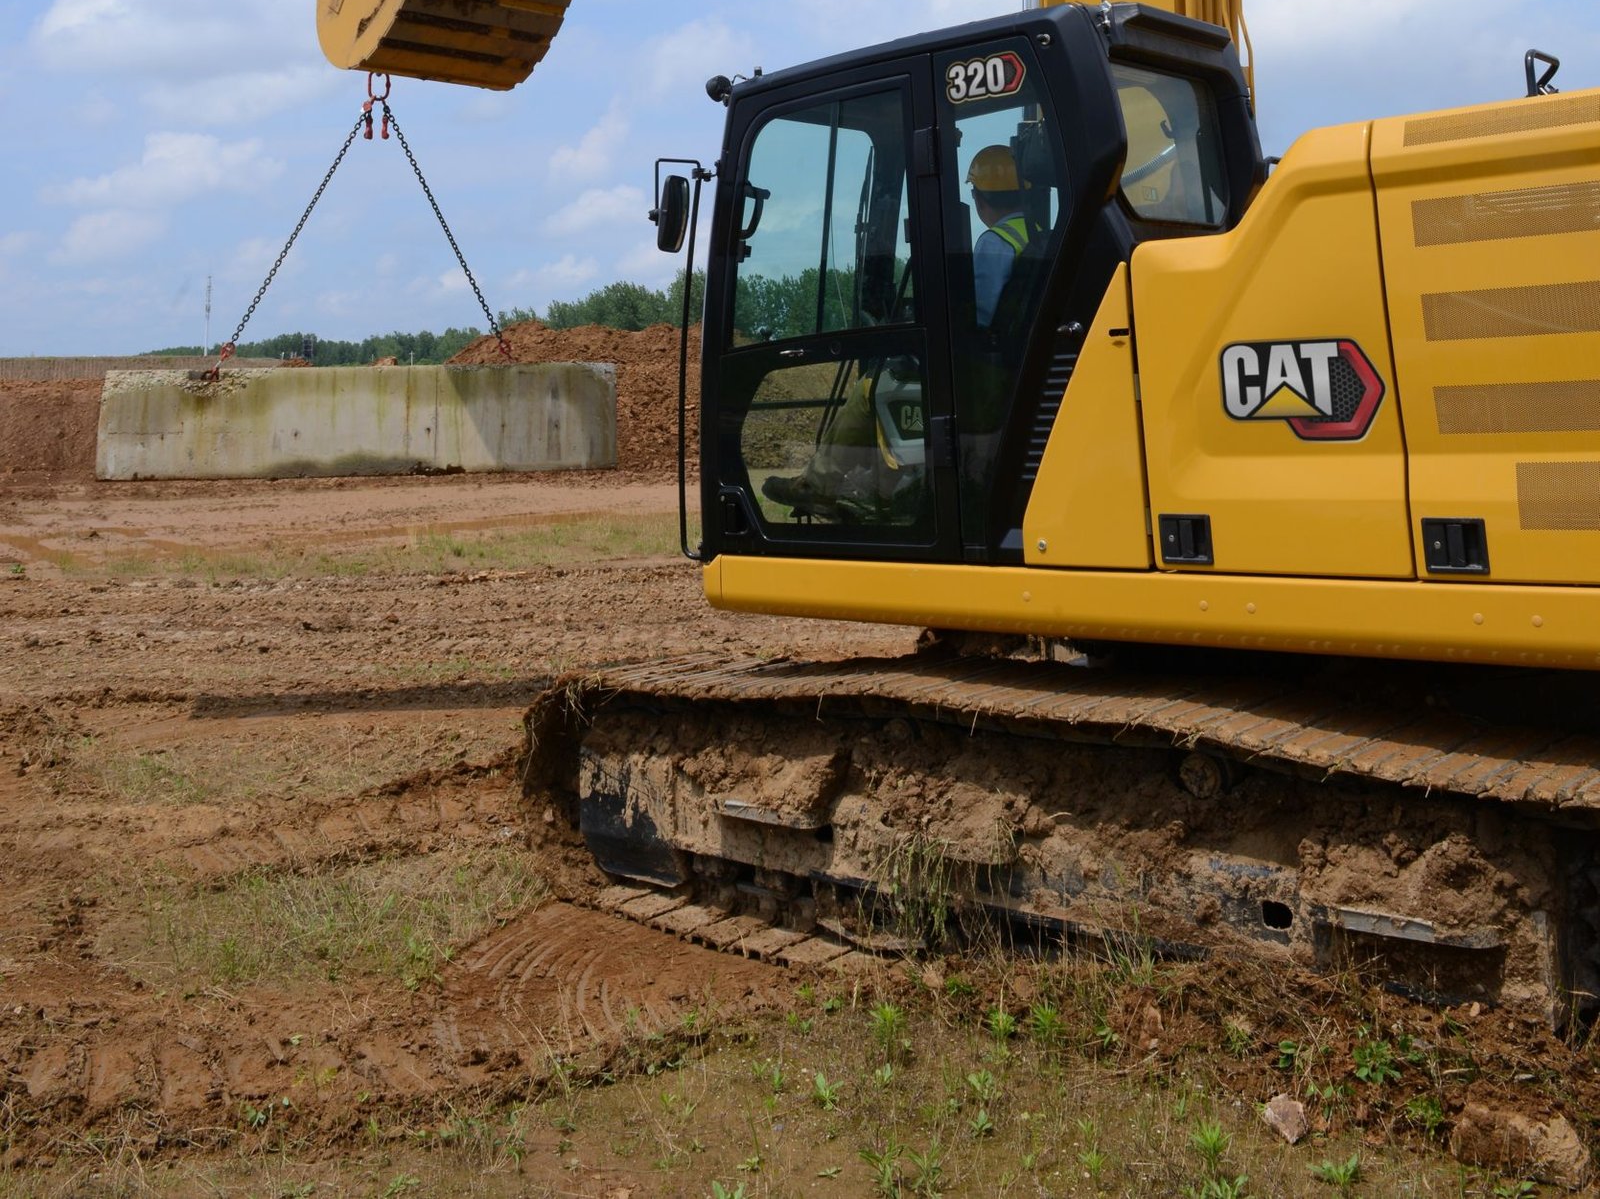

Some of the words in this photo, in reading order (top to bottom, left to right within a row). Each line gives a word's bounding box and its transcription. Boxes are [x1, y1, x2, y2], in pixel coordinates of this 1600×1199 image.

[948, 57, 1006, 101] 320
[1222, 341, 1339, 418] CAT
[901, 405, 924, 431] CA
